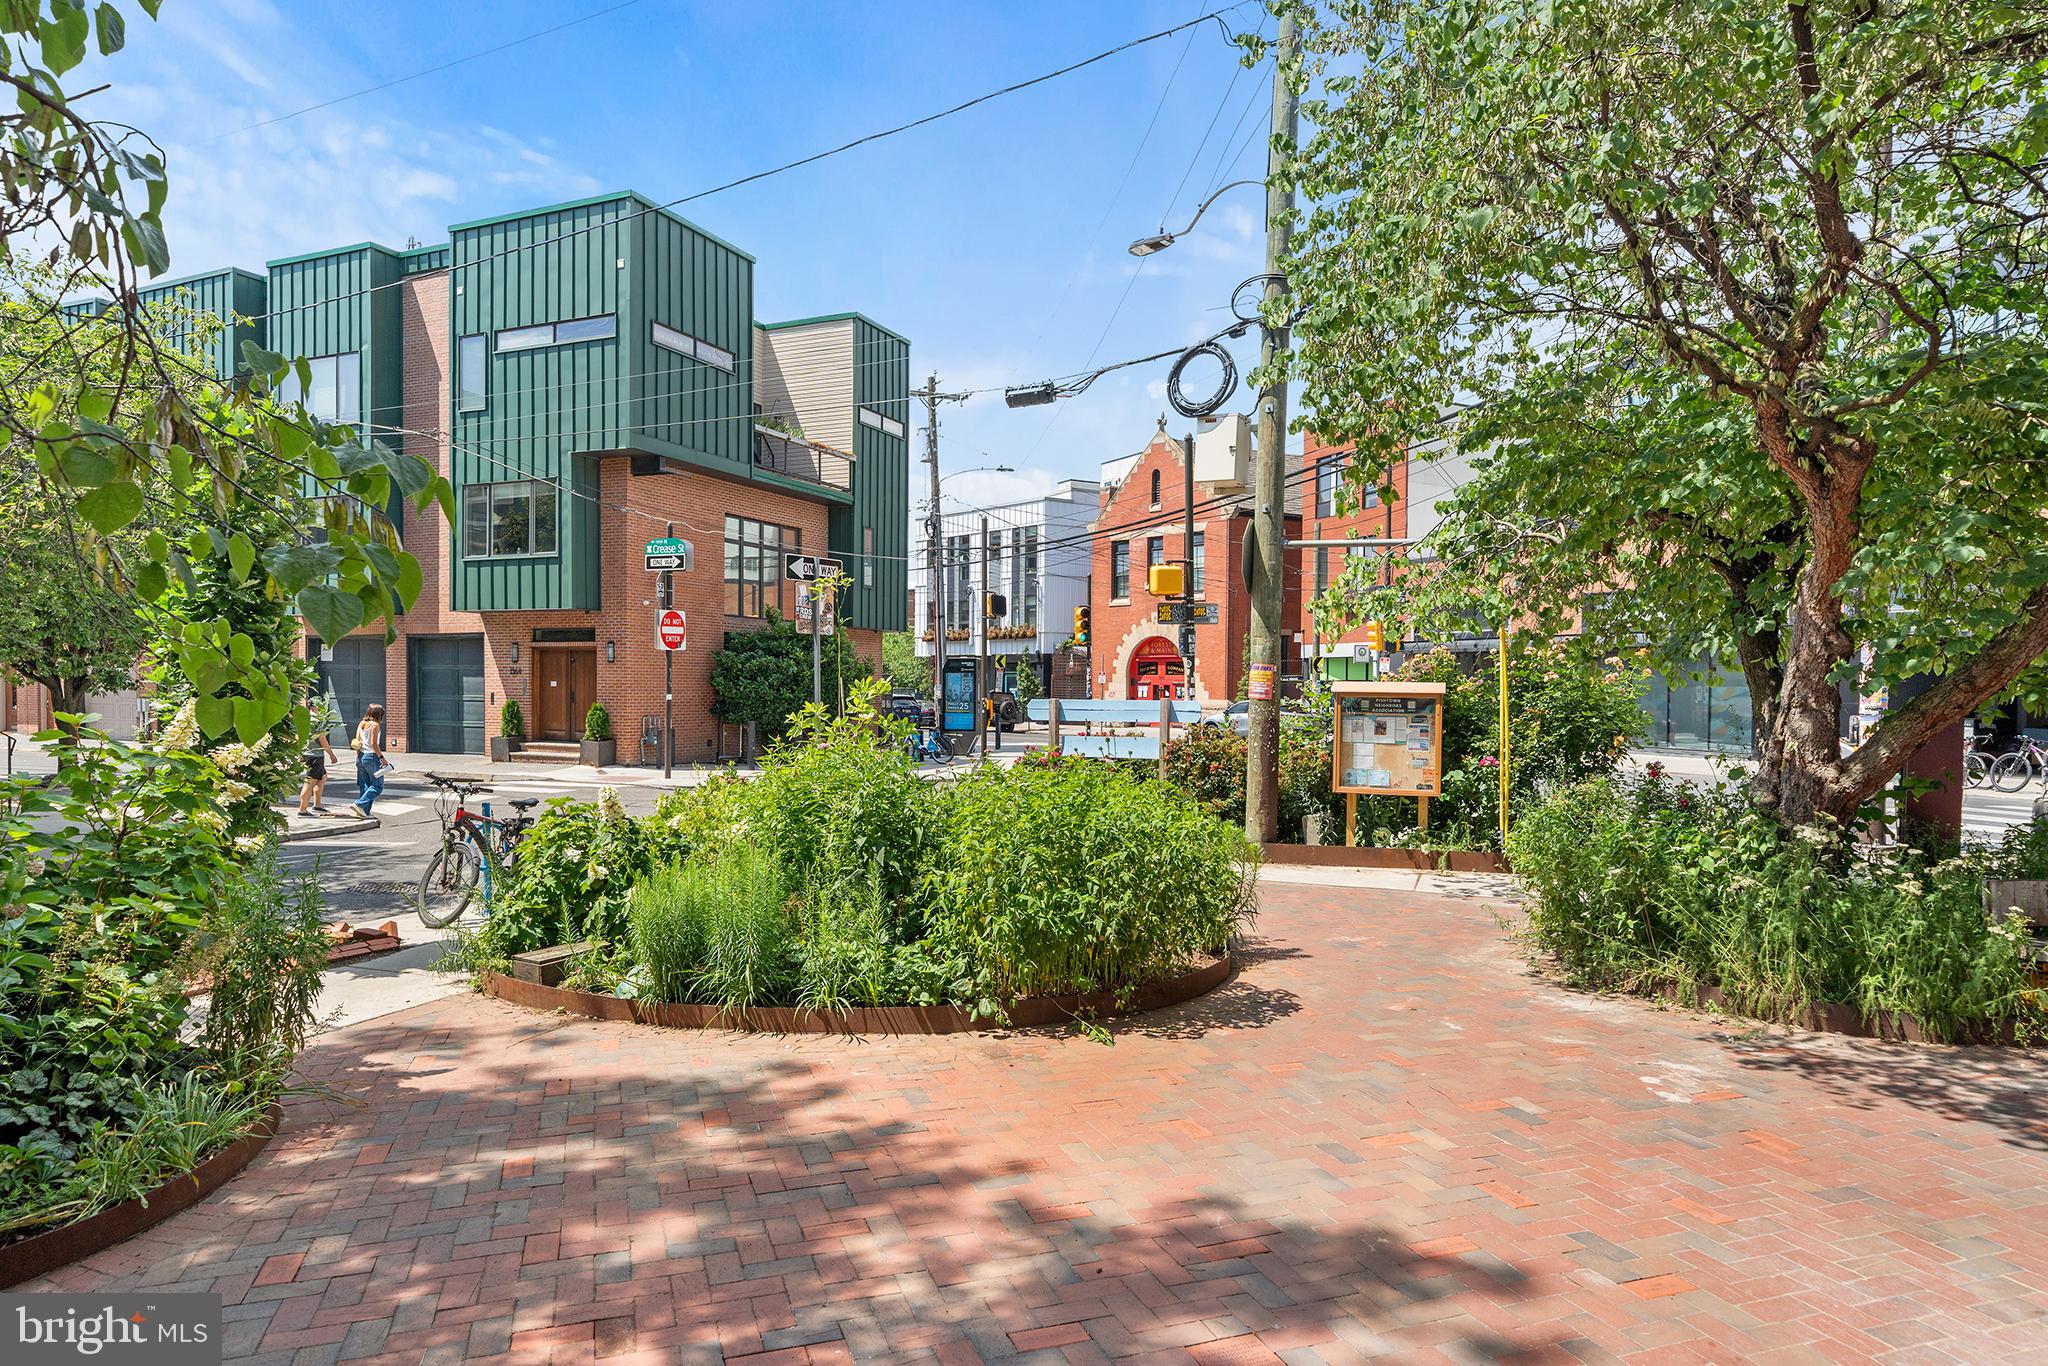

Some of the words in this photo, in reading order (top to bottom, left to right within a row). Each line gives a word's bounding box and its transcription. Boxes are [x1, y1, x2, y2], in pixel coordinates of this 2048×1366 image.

[653, 544, 676, 554] Crease
[677, 543, 685, 553] St
[803, 563, 814, 575] ON
[821, 566, 836, 576] WAY
[959, 702, 969, 710] 25
